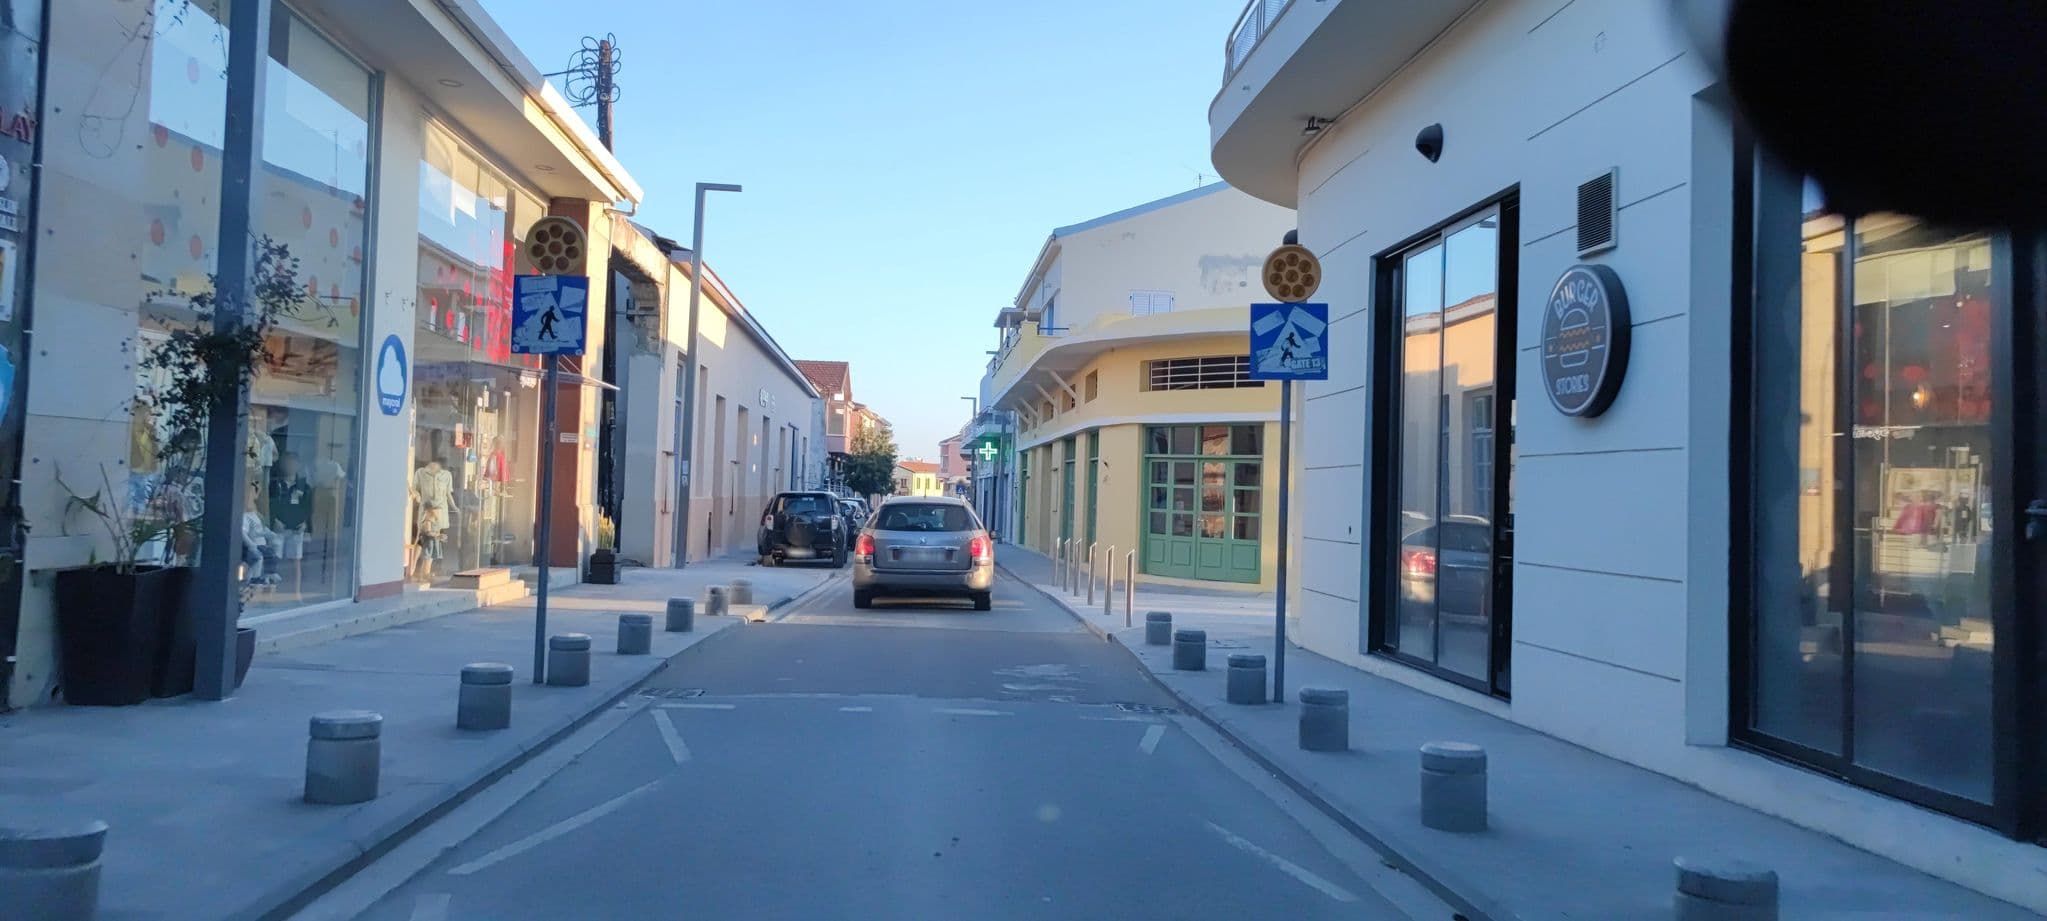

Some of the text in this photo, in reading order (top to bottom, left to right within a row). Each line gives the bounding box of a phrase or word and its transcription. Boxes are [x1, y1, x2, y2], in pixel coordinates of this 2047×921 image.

[1554, 280, 1598, 320] BURGER
[1291, 358, 1310, 369] GATE
[1556, 374, 1589, 396] STORIES
